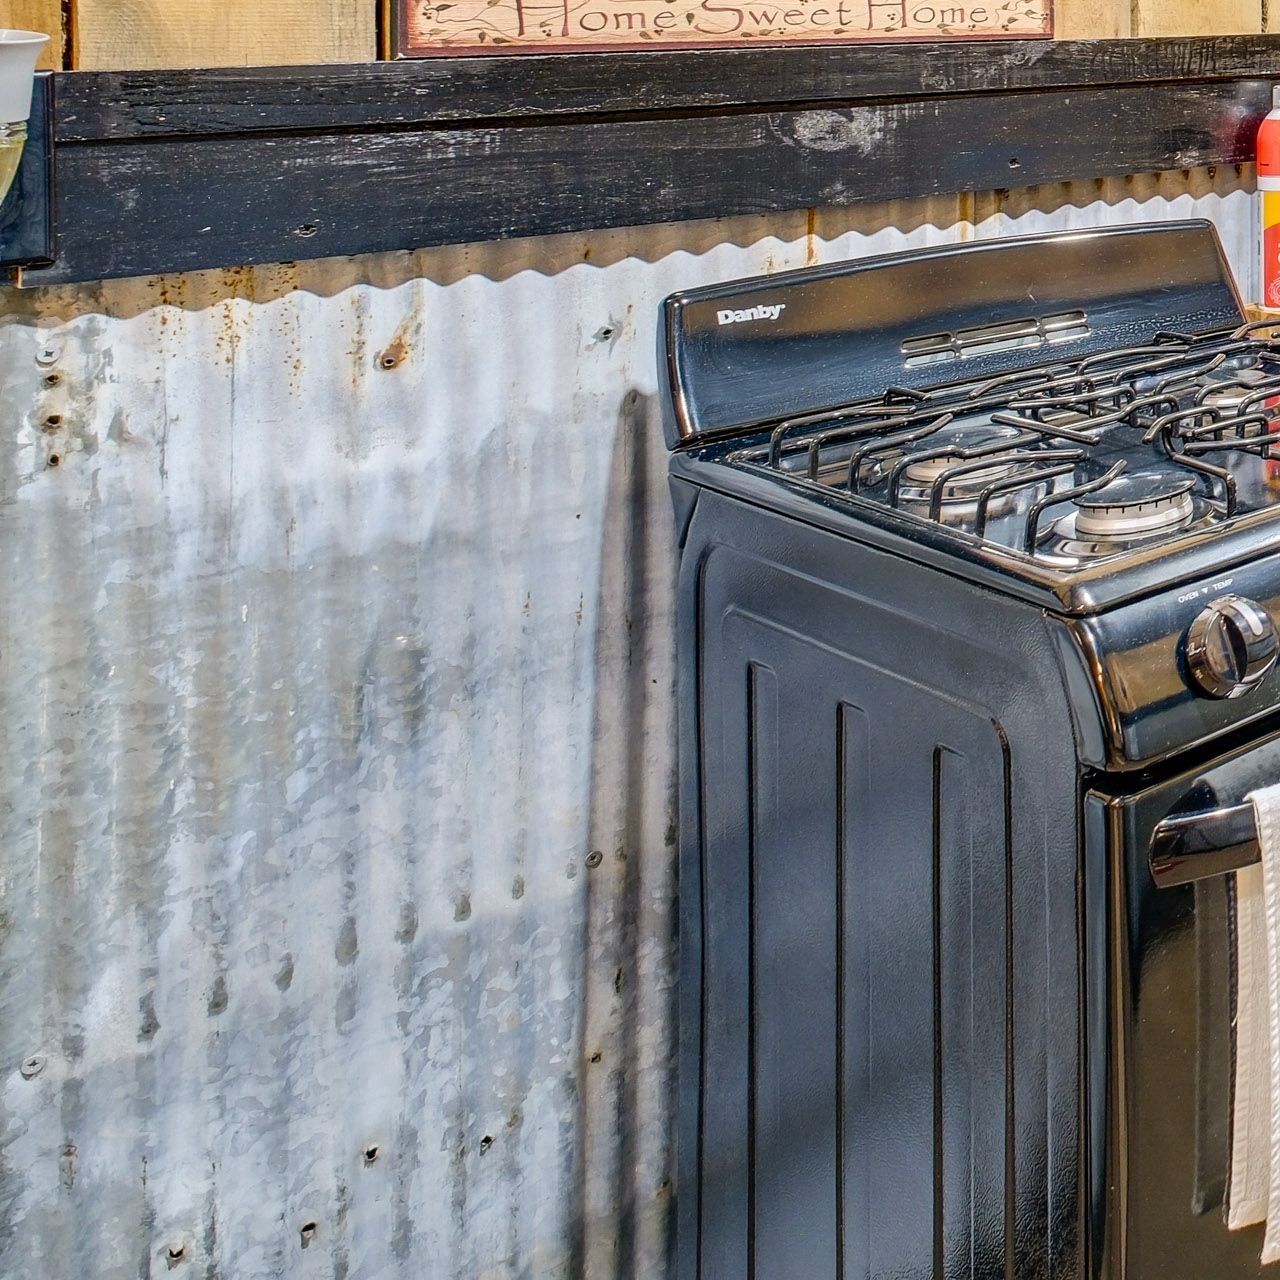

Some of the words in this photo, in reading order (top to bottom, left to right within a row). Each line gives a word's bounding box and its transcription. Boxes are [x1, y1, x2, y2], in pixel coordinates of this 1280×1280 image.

[716, 302, 786, 326] Danby
[1178, 590, 1199, 604] OVEN
[1211, 578, 1234, 591] TEMP
